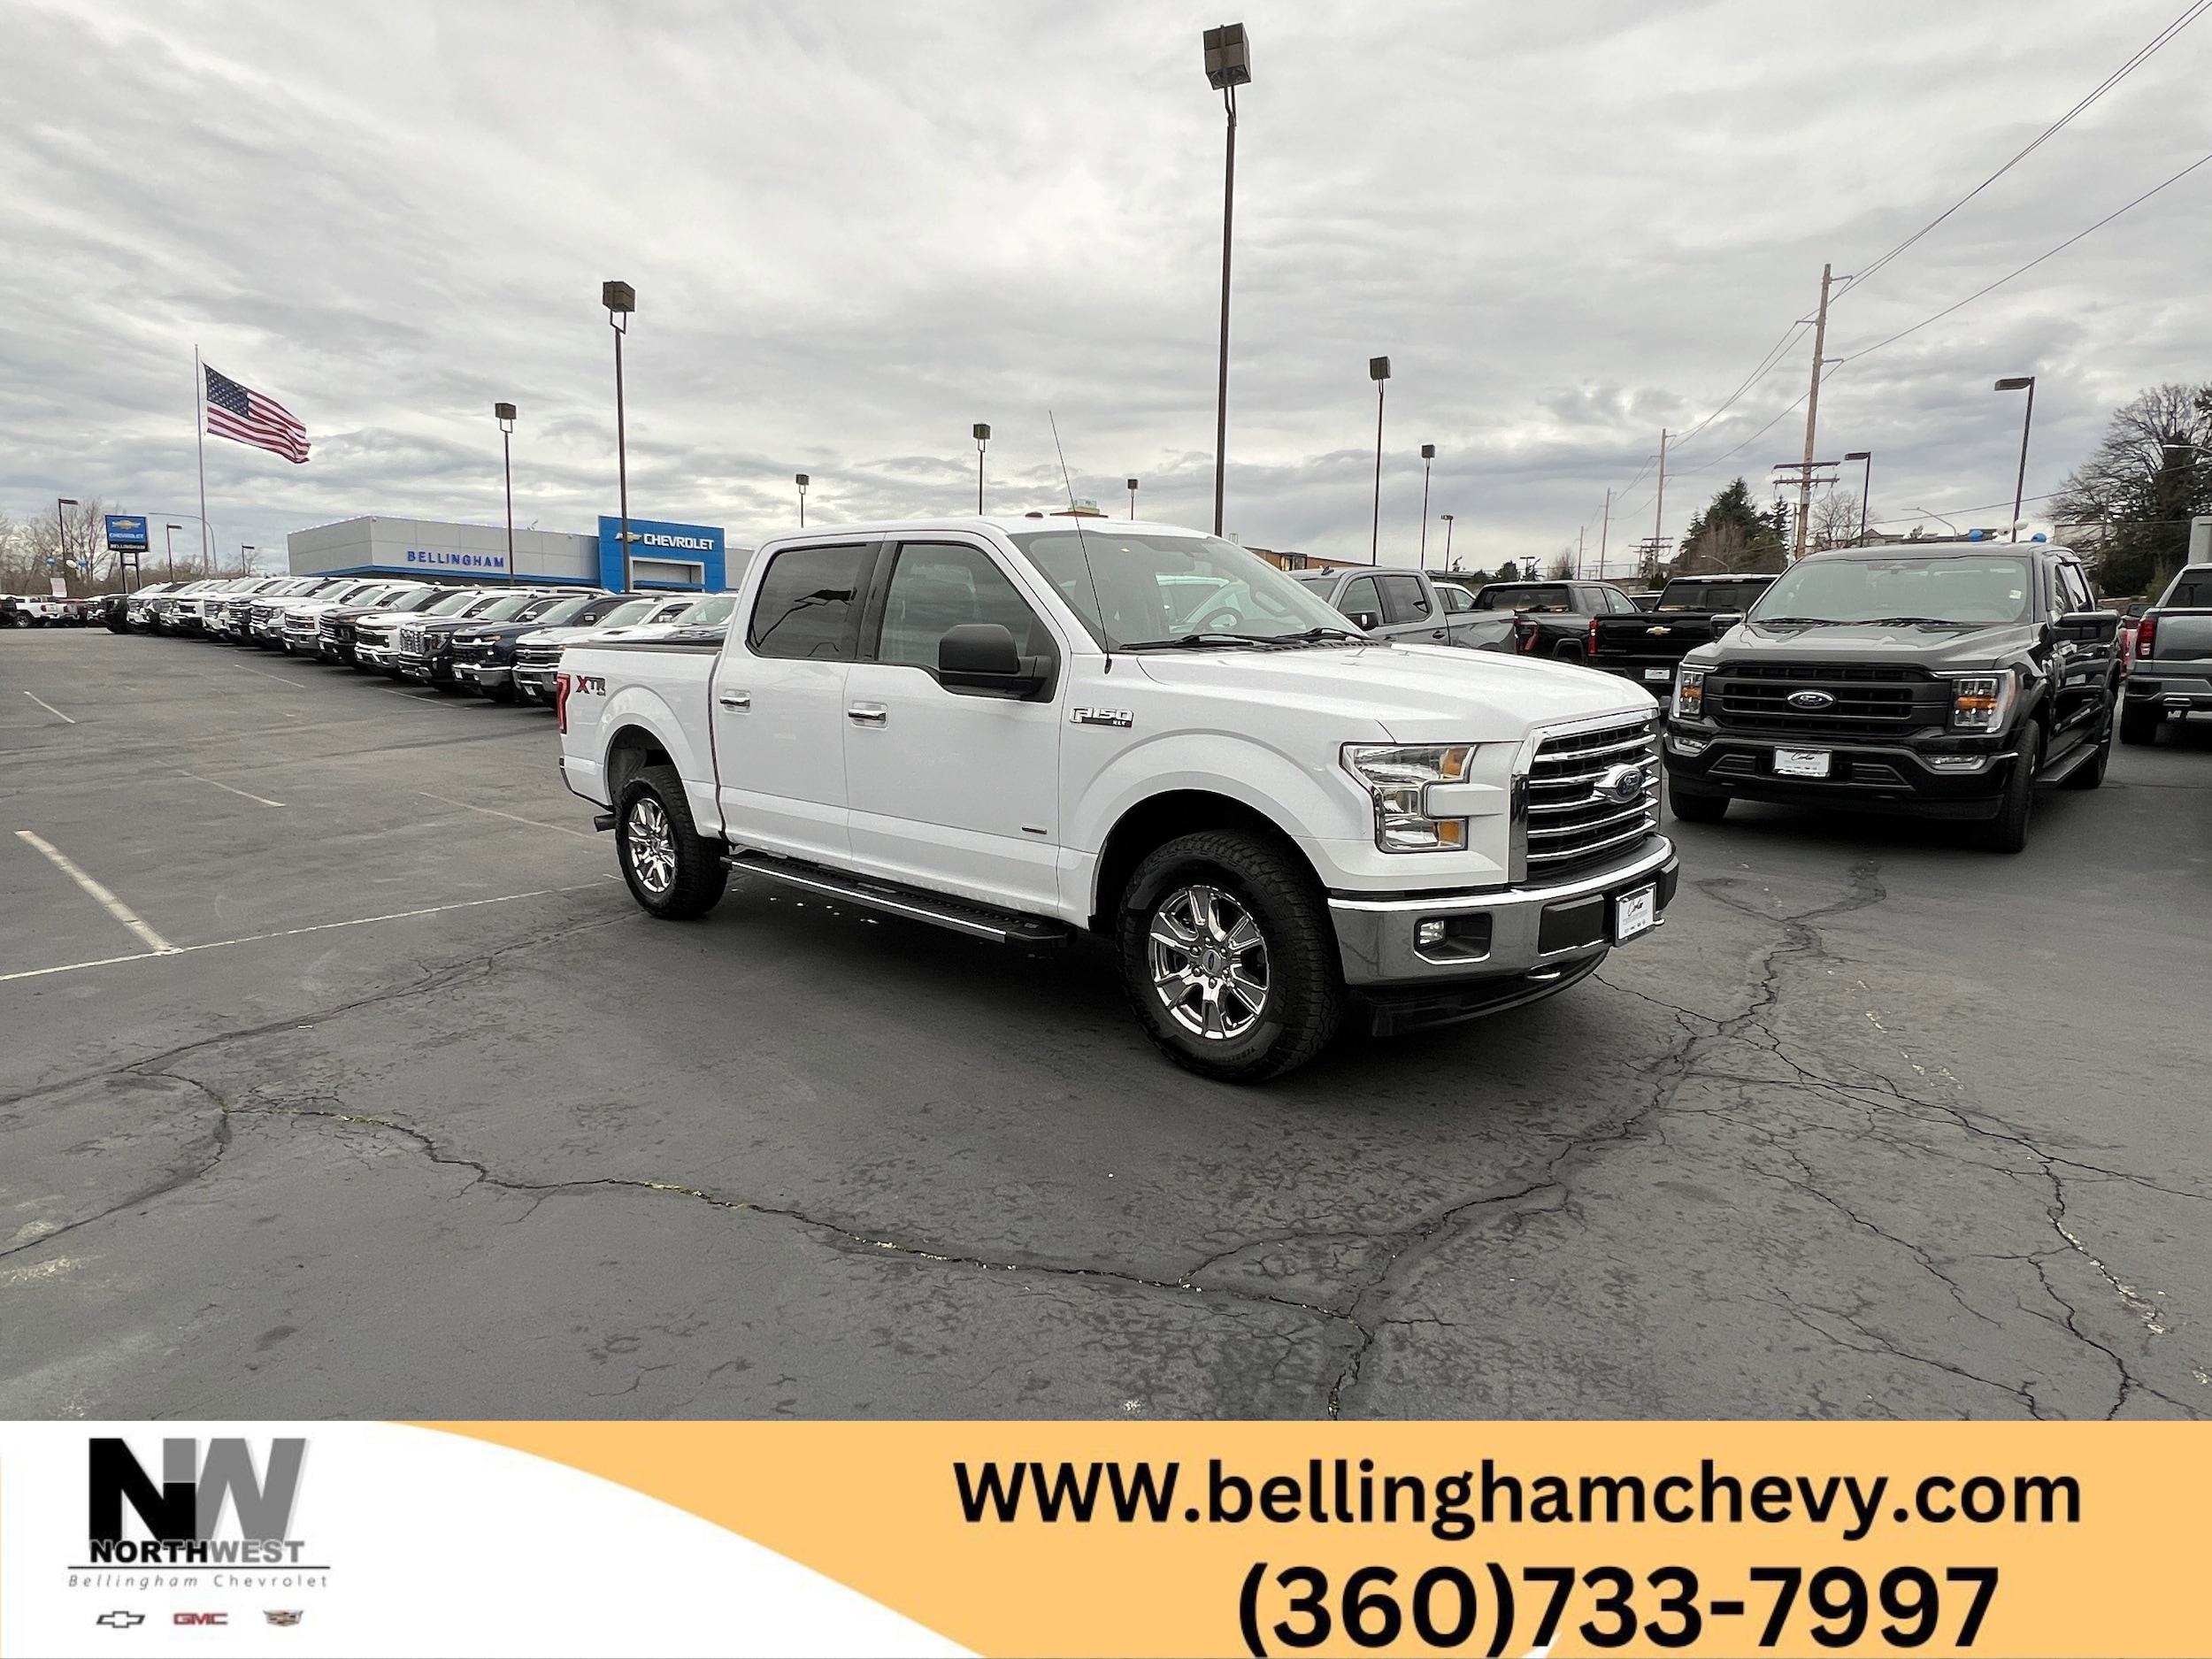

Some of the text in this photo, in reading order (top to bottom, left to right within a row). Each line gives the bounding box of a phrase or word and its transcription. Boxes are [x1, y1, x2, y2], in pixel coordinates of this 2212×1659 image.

[643, 533, 714, 550] CHEVROLET
[407, 550, 504, 568] BELLINGHAM
[575, 675, 606, 694] XTR
